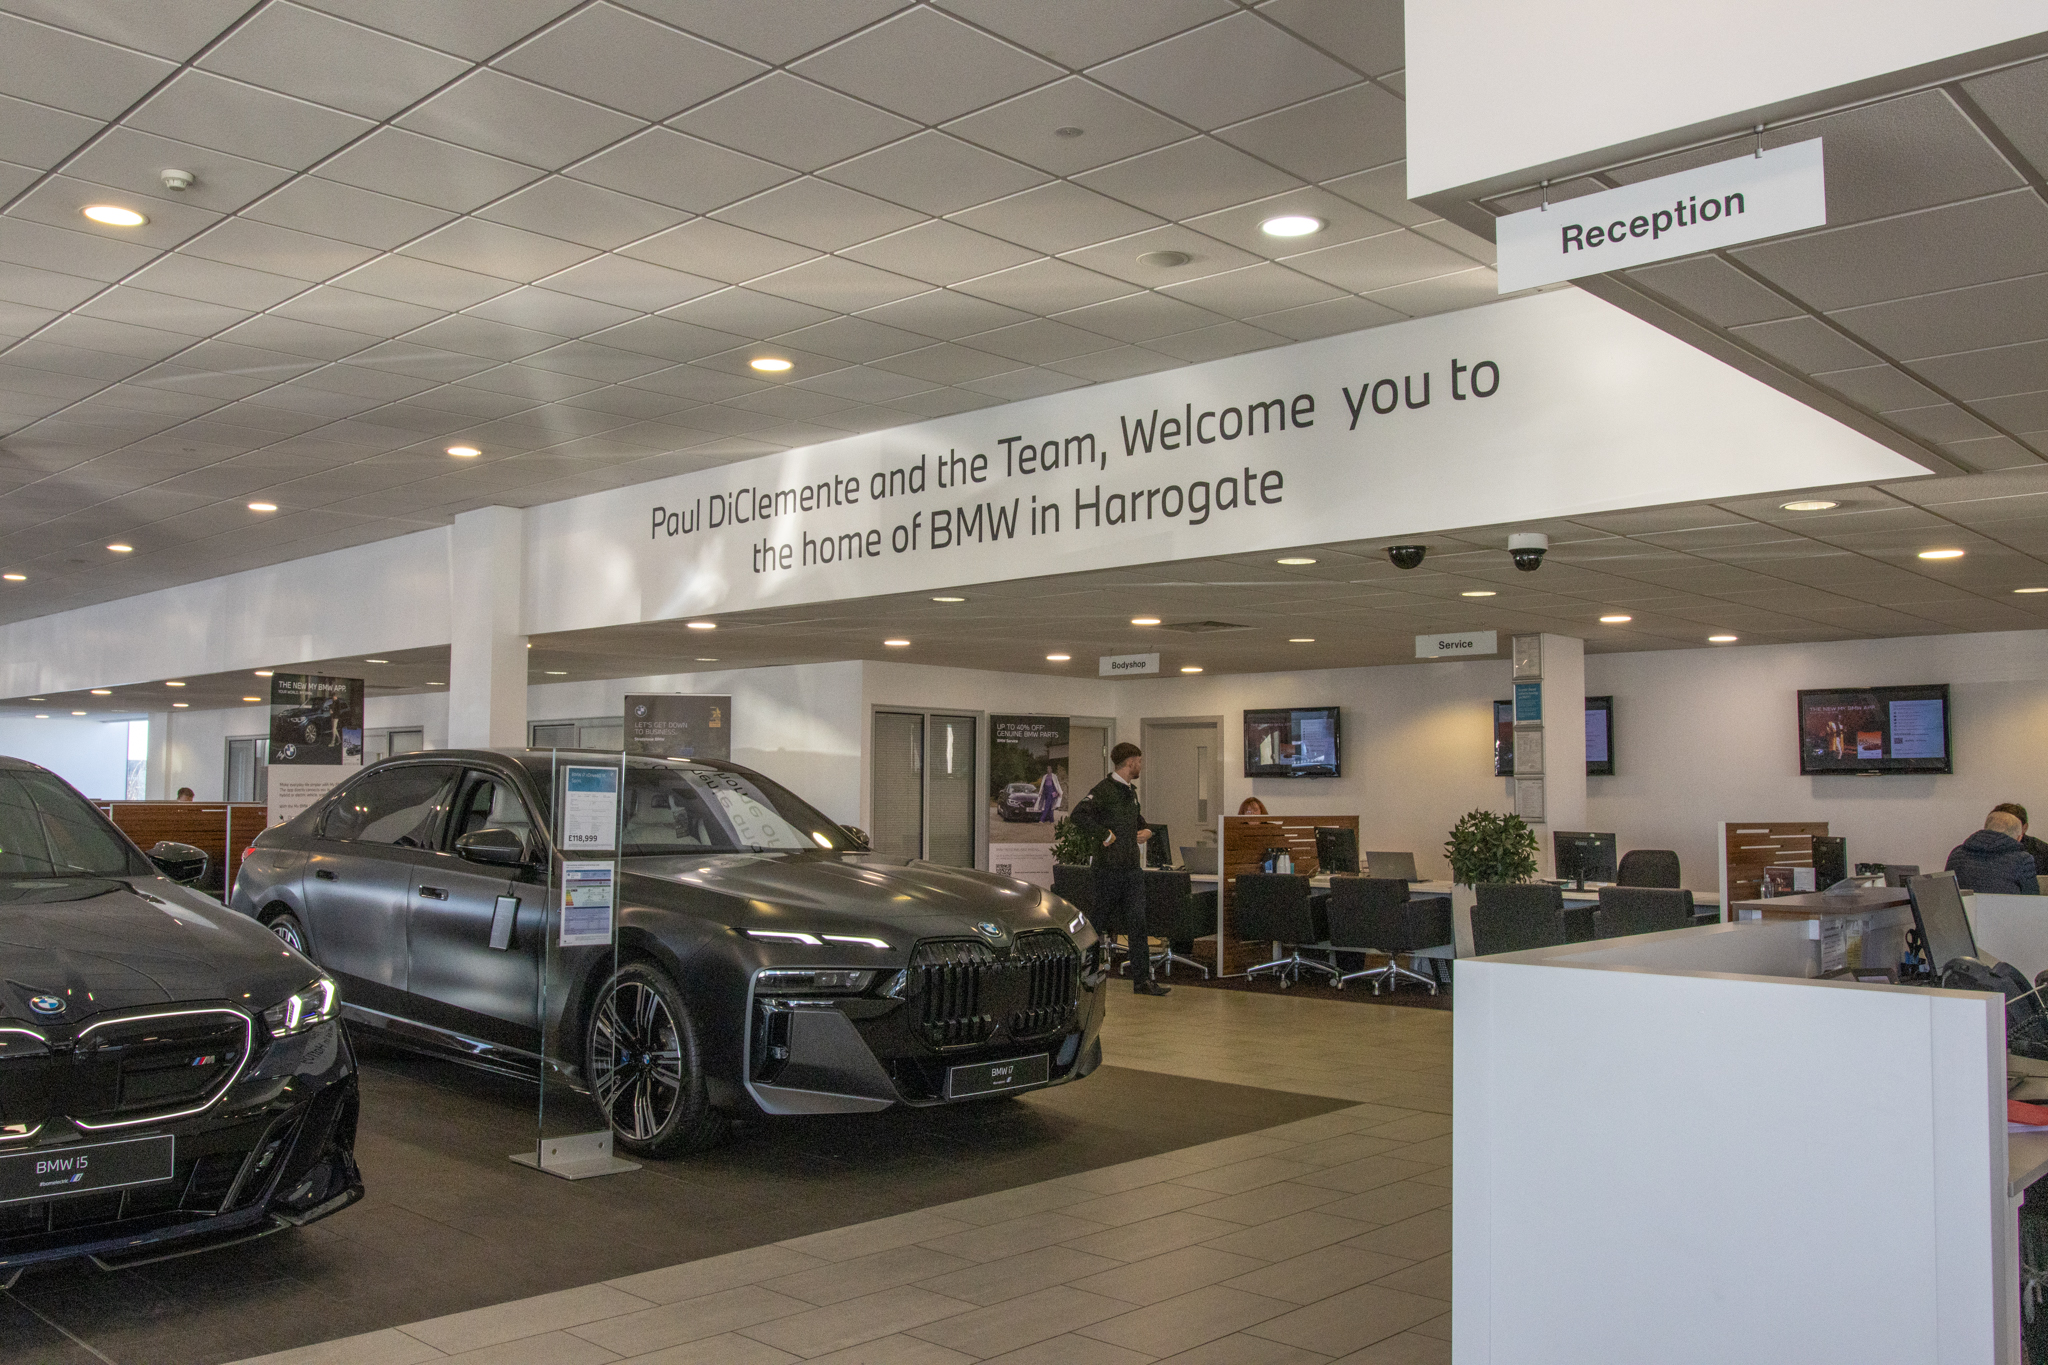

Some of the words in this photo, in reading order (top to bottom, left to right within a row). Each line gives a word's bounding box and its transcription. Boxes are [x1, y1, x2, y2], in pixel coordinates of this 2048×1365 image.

[1561, 192, 1745, 254] Reception
[651, 498, 701, 540] Paul
[709, 475, 860, 529] DiClemente
[870, 454, 926, 501] and
[937, 448, 988, 489] the
[997, 433, 1107, 478] Team,
[1120, 393, 1315, 457] Welcome
[1341, 372, 1431, 431] you
[1451, 358, 1500, 401] to
[753, 537, 793, 574] the
[802, 529, 882, 567] home
[891, 510, 922, 554] of
[930, 497, 1020, 550] BMW
[1031, 496, 1060, 536] in
[1075, 466, 1284, 530] Harrogate
[1438, 639, 1473, 650] Service
[1111, 660, 1146, 671] Bodyshop
[278, 680, 292, 689] THE
[292, 681, 307, 690] NEW
[308, 682, 317, 690] MY
[318, 683, 333, 691] BMW
[634, 721, 653, 729] LET'S
[653, 721, 667, 729] GET
[996, 730, 1023, 738] GENUINE
[1039, 731, 1059, 739] PARTS
[568, 834, 598, 843] £118,999
[991, 1066, 1008, 1077] BMW
[36, 1157, 74, 1174] BMW
[76, 1155, 89, 1169] i5
